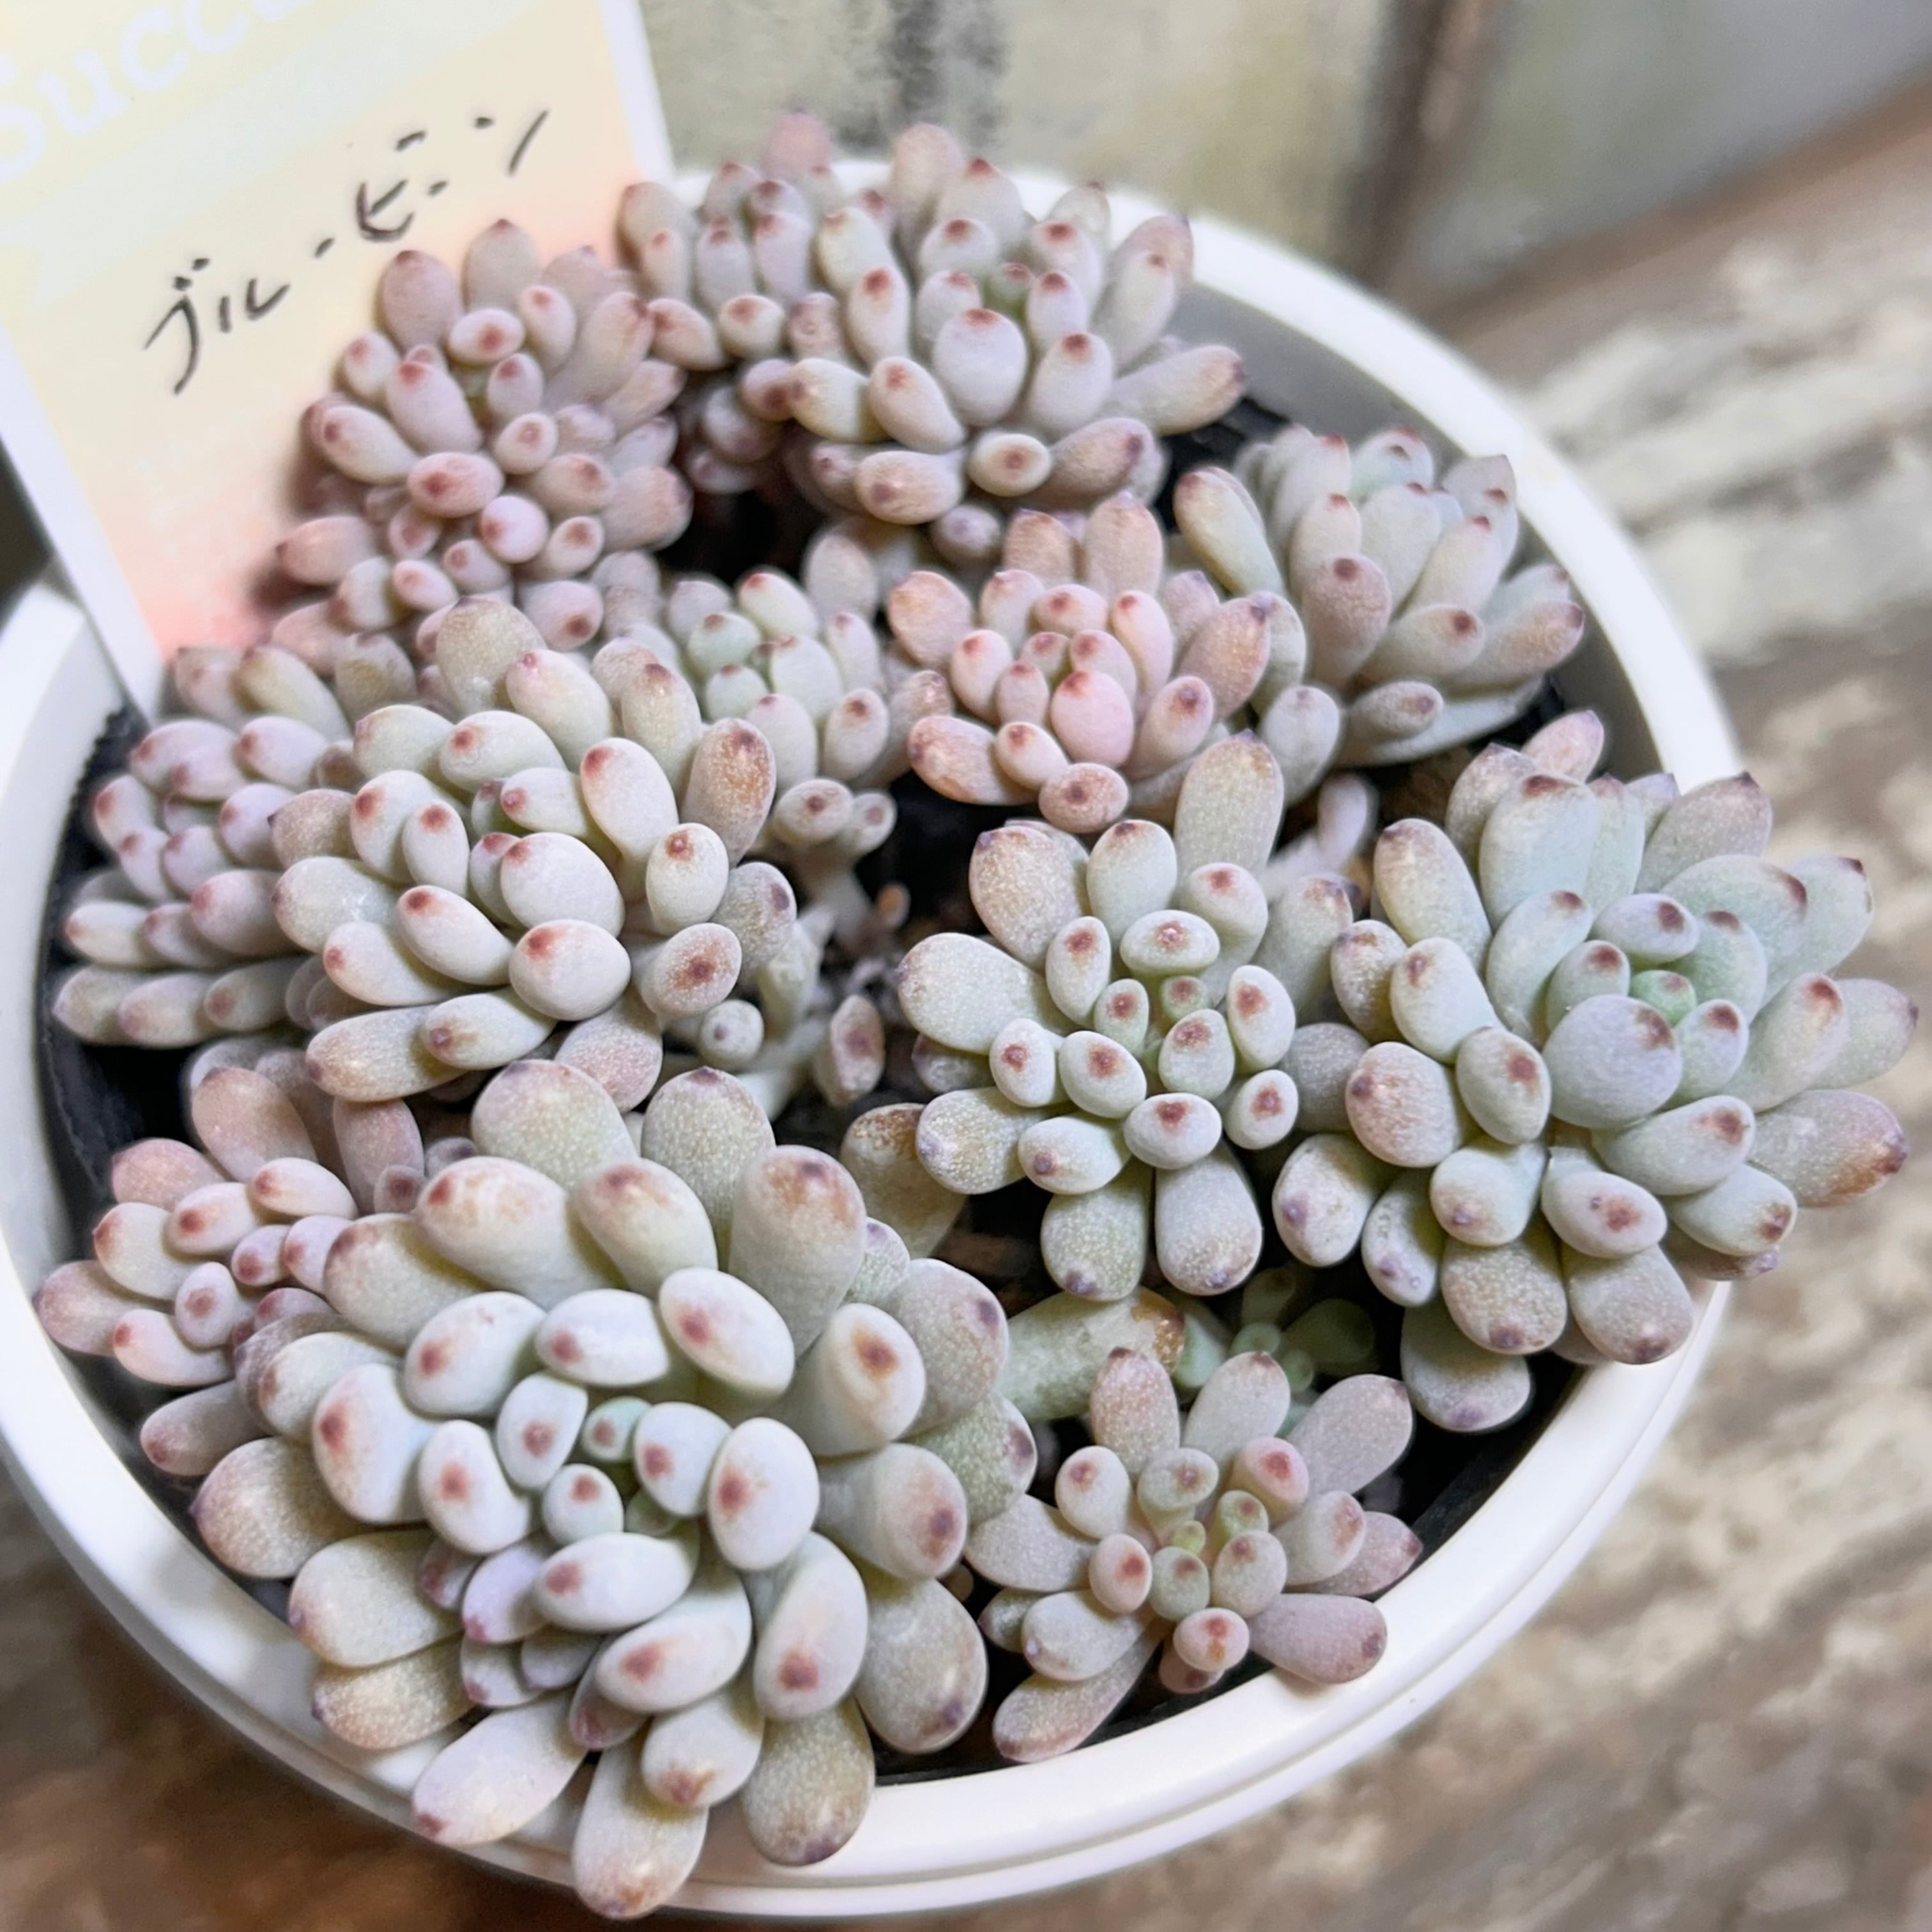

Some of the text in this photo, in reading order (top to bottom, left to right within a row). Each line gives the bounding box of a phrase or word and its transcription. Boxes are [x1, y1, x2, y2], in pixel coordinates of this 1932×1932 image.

[143, 109, 549, 395] ブルービーン
